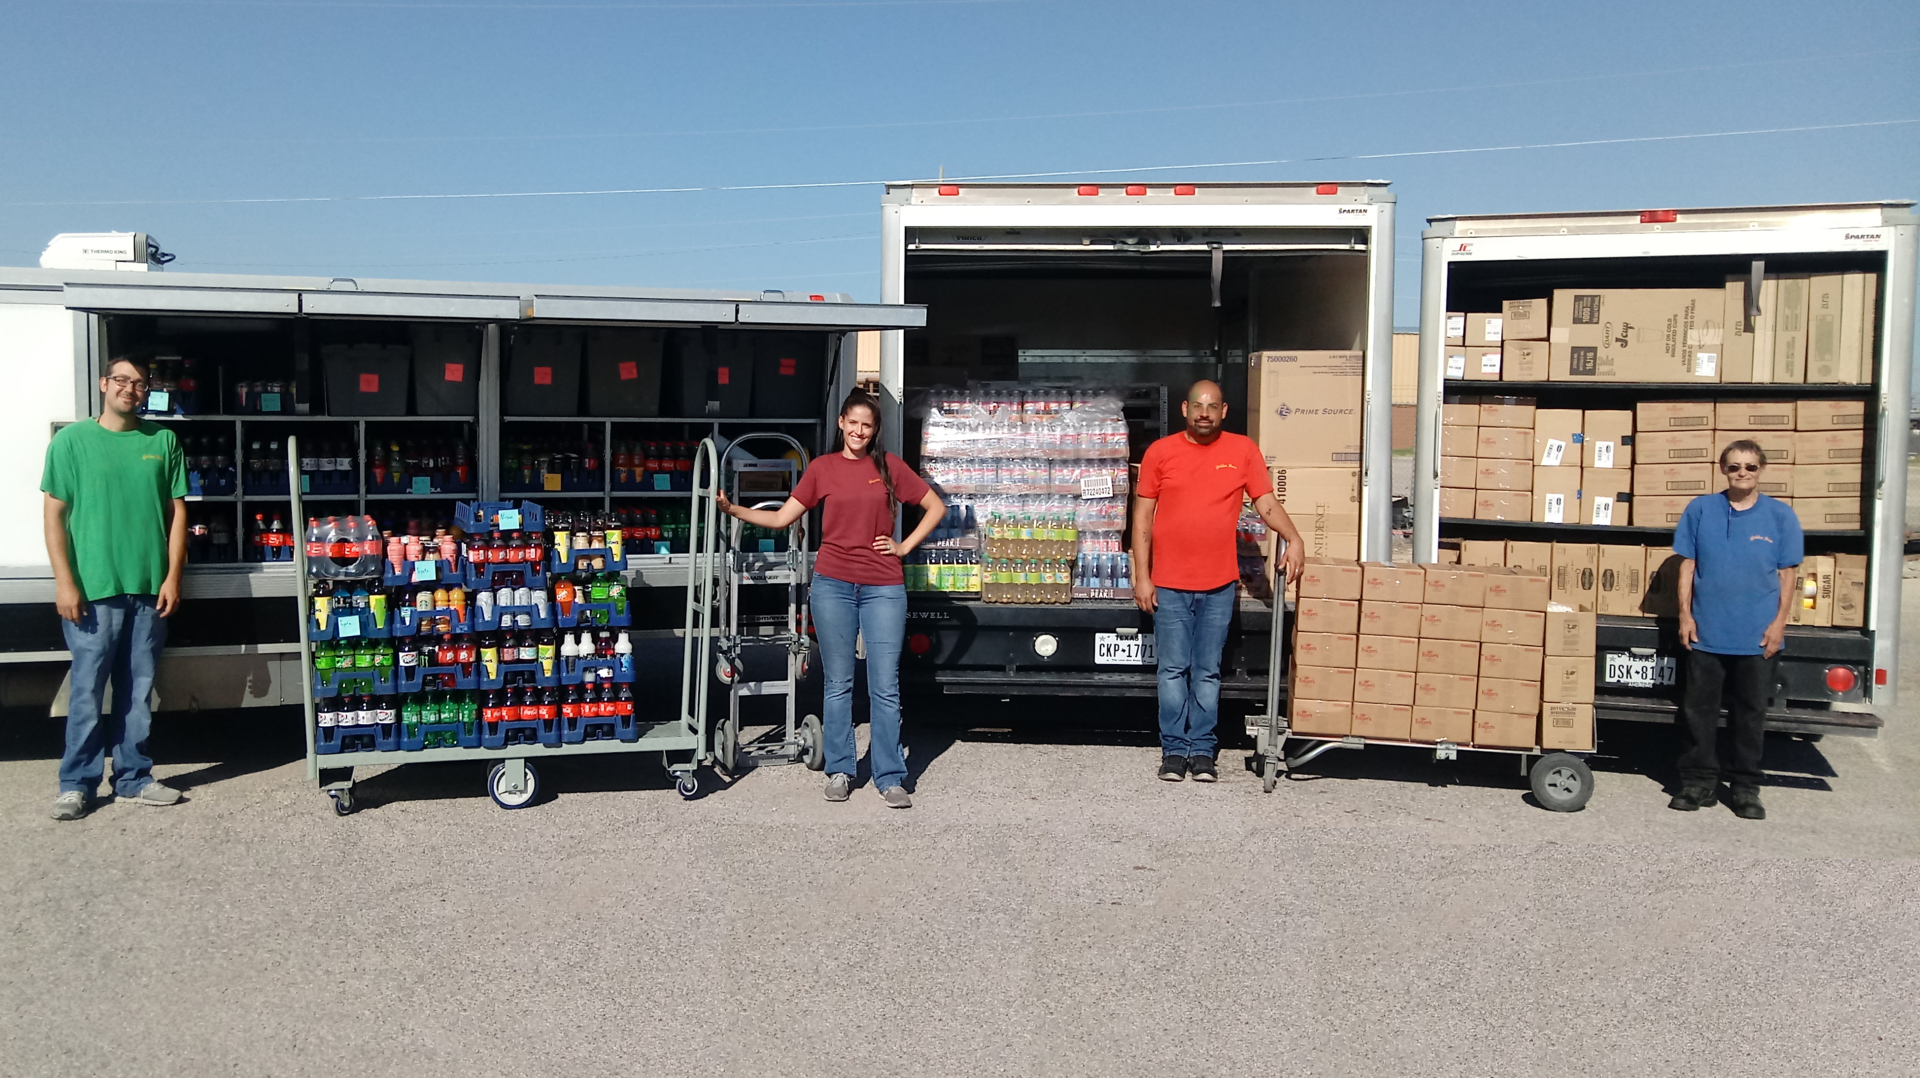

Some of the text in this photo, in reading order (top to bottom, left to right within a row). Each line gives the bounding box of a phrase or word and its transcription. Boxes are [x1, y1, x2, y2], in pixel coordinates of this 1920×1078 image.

[1266, 355, 1298, 363] 75000260
[1822, 574, 1832, 599] SUGAR
[905, 611, 950, 619] SEWELL
[1099, 643, 1155, 659] CKP 1771
[1609, 664, 1674, 682] DSK 8147
